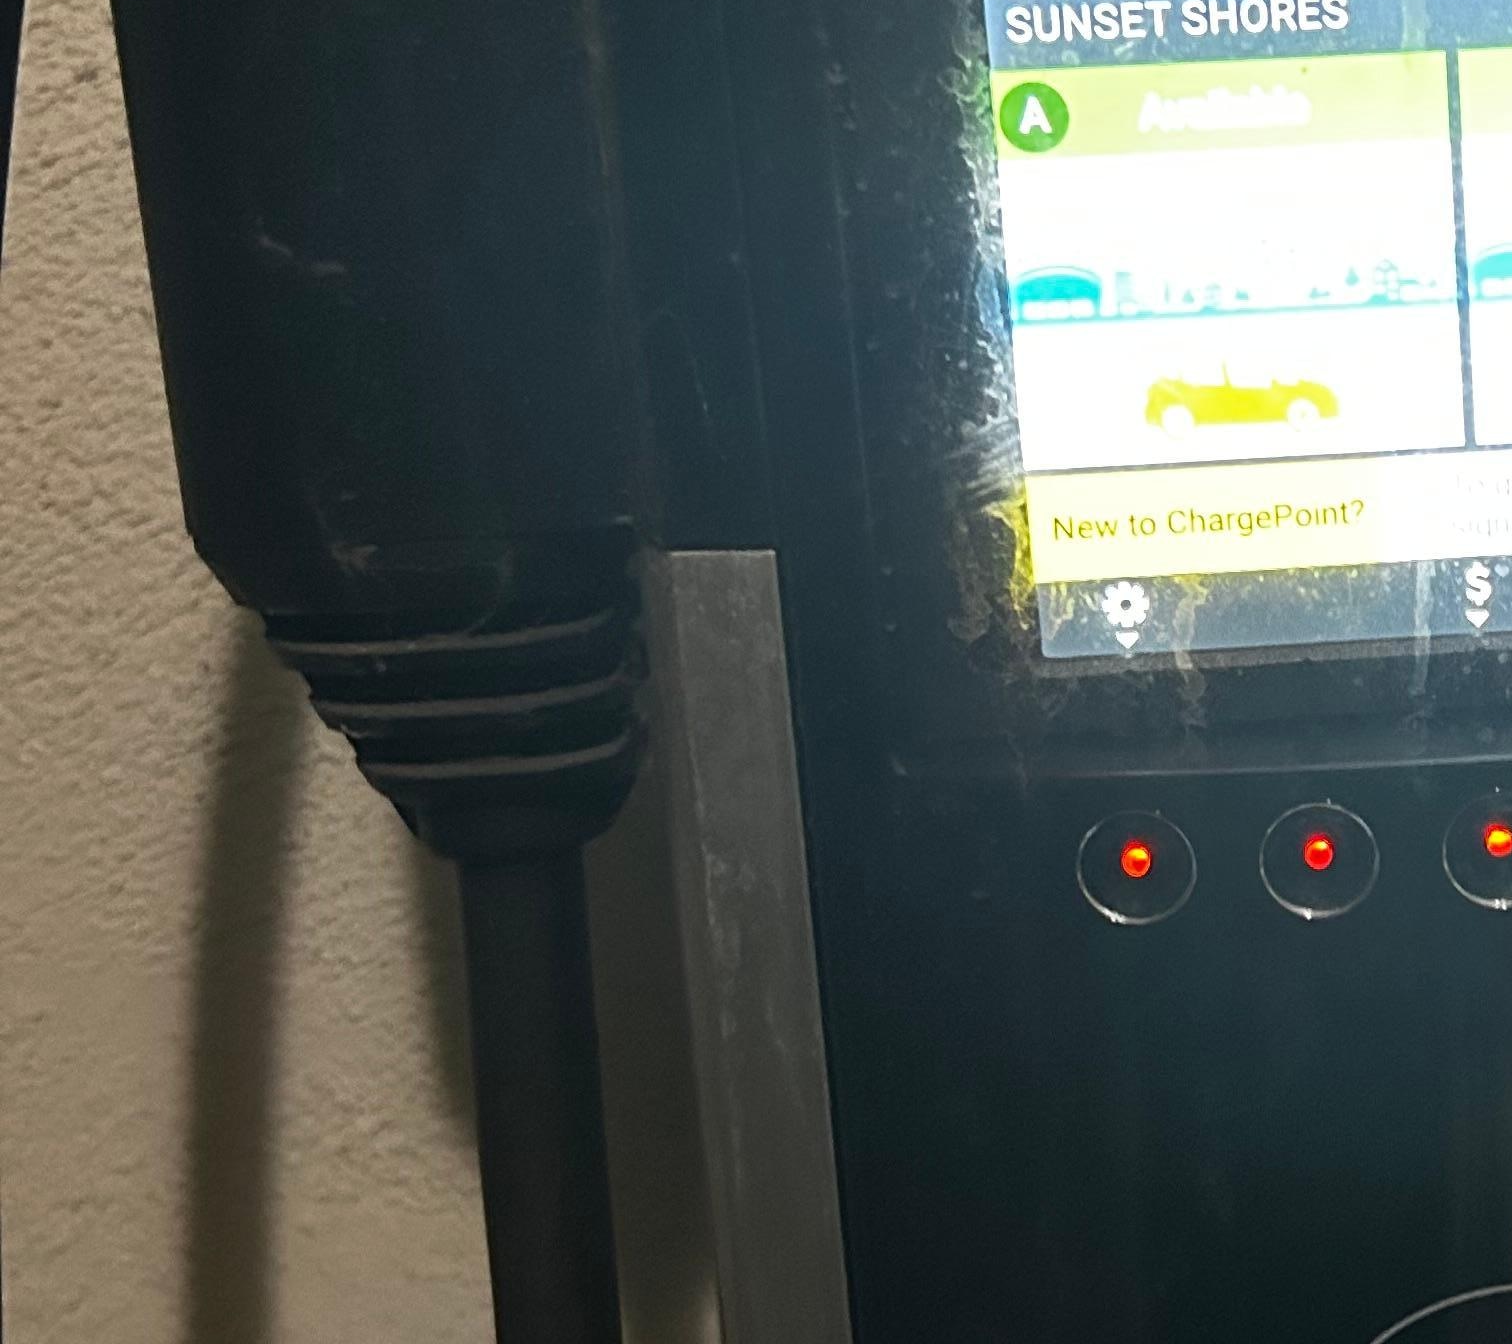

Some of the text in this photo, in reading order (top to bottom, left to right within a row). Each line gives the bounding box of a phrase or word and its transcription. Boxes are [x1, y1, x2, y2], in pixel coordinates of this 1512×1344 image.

[1005, 0, 1171, 45] SUNSET
[1018, 95, 1053, 135] A
[1052, 499, 1366, 541] New to ChargePoint?
